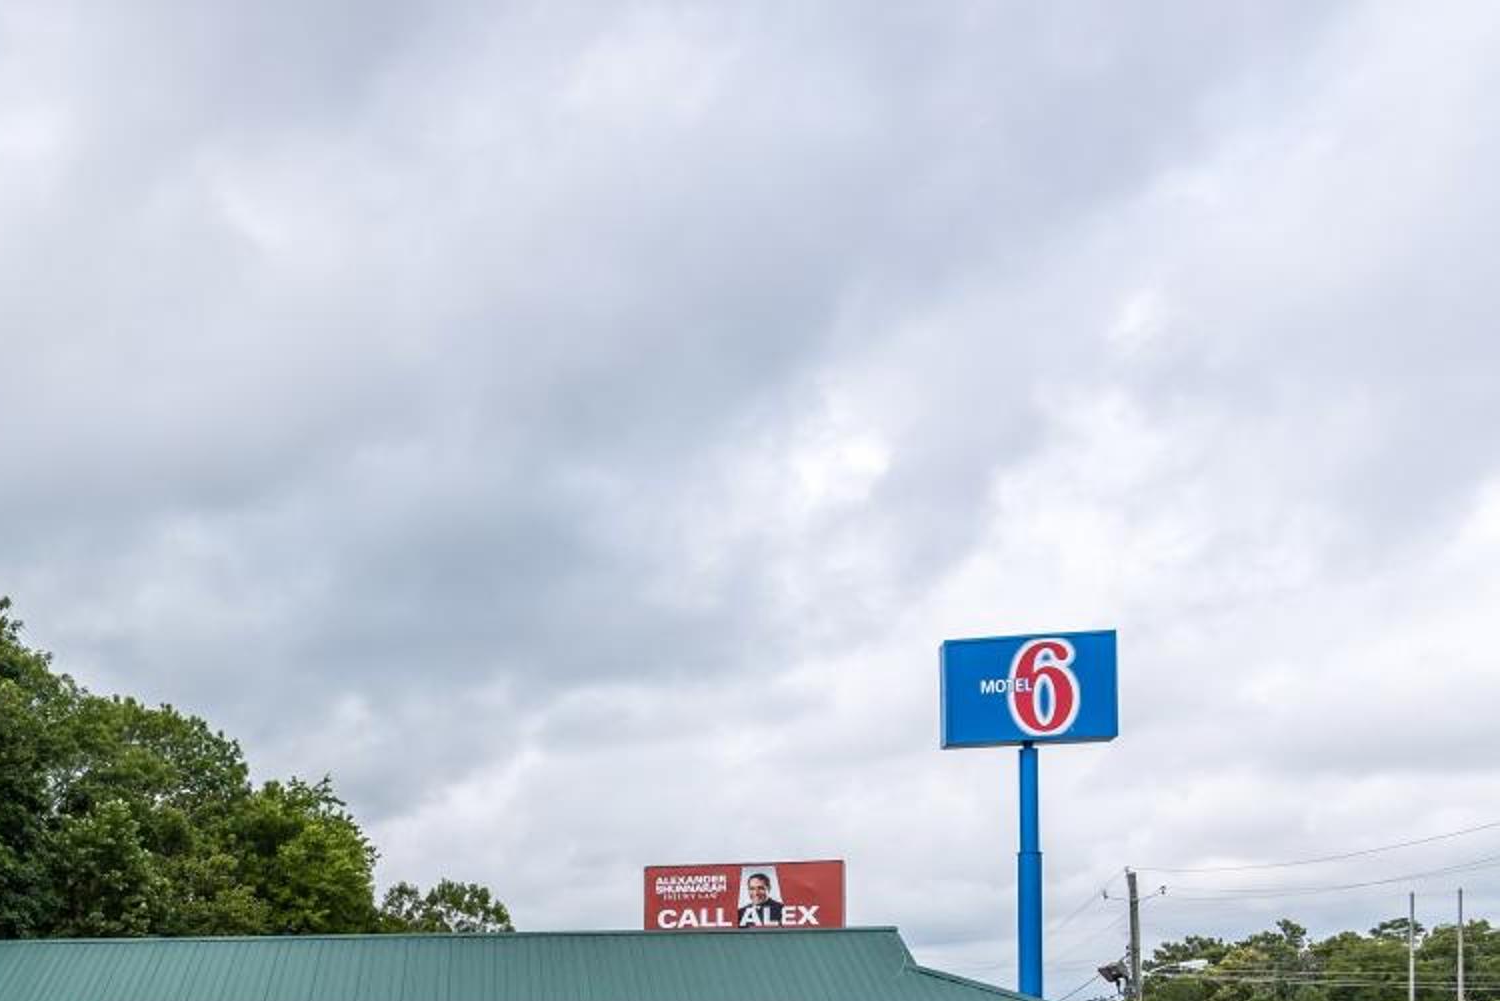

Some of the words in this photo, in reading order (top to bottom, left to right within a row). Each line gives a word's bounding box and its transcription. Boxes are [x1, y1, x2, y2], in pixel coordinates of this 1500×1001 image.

[981, 679, 1033, 694] MOTEL
[1008, 638, 1081, 736] 6
[656, 875, 727, 886] ALEXANDER
[657, 908, 732, 929] CALL
[740, 905, 819, 927] ALEX
